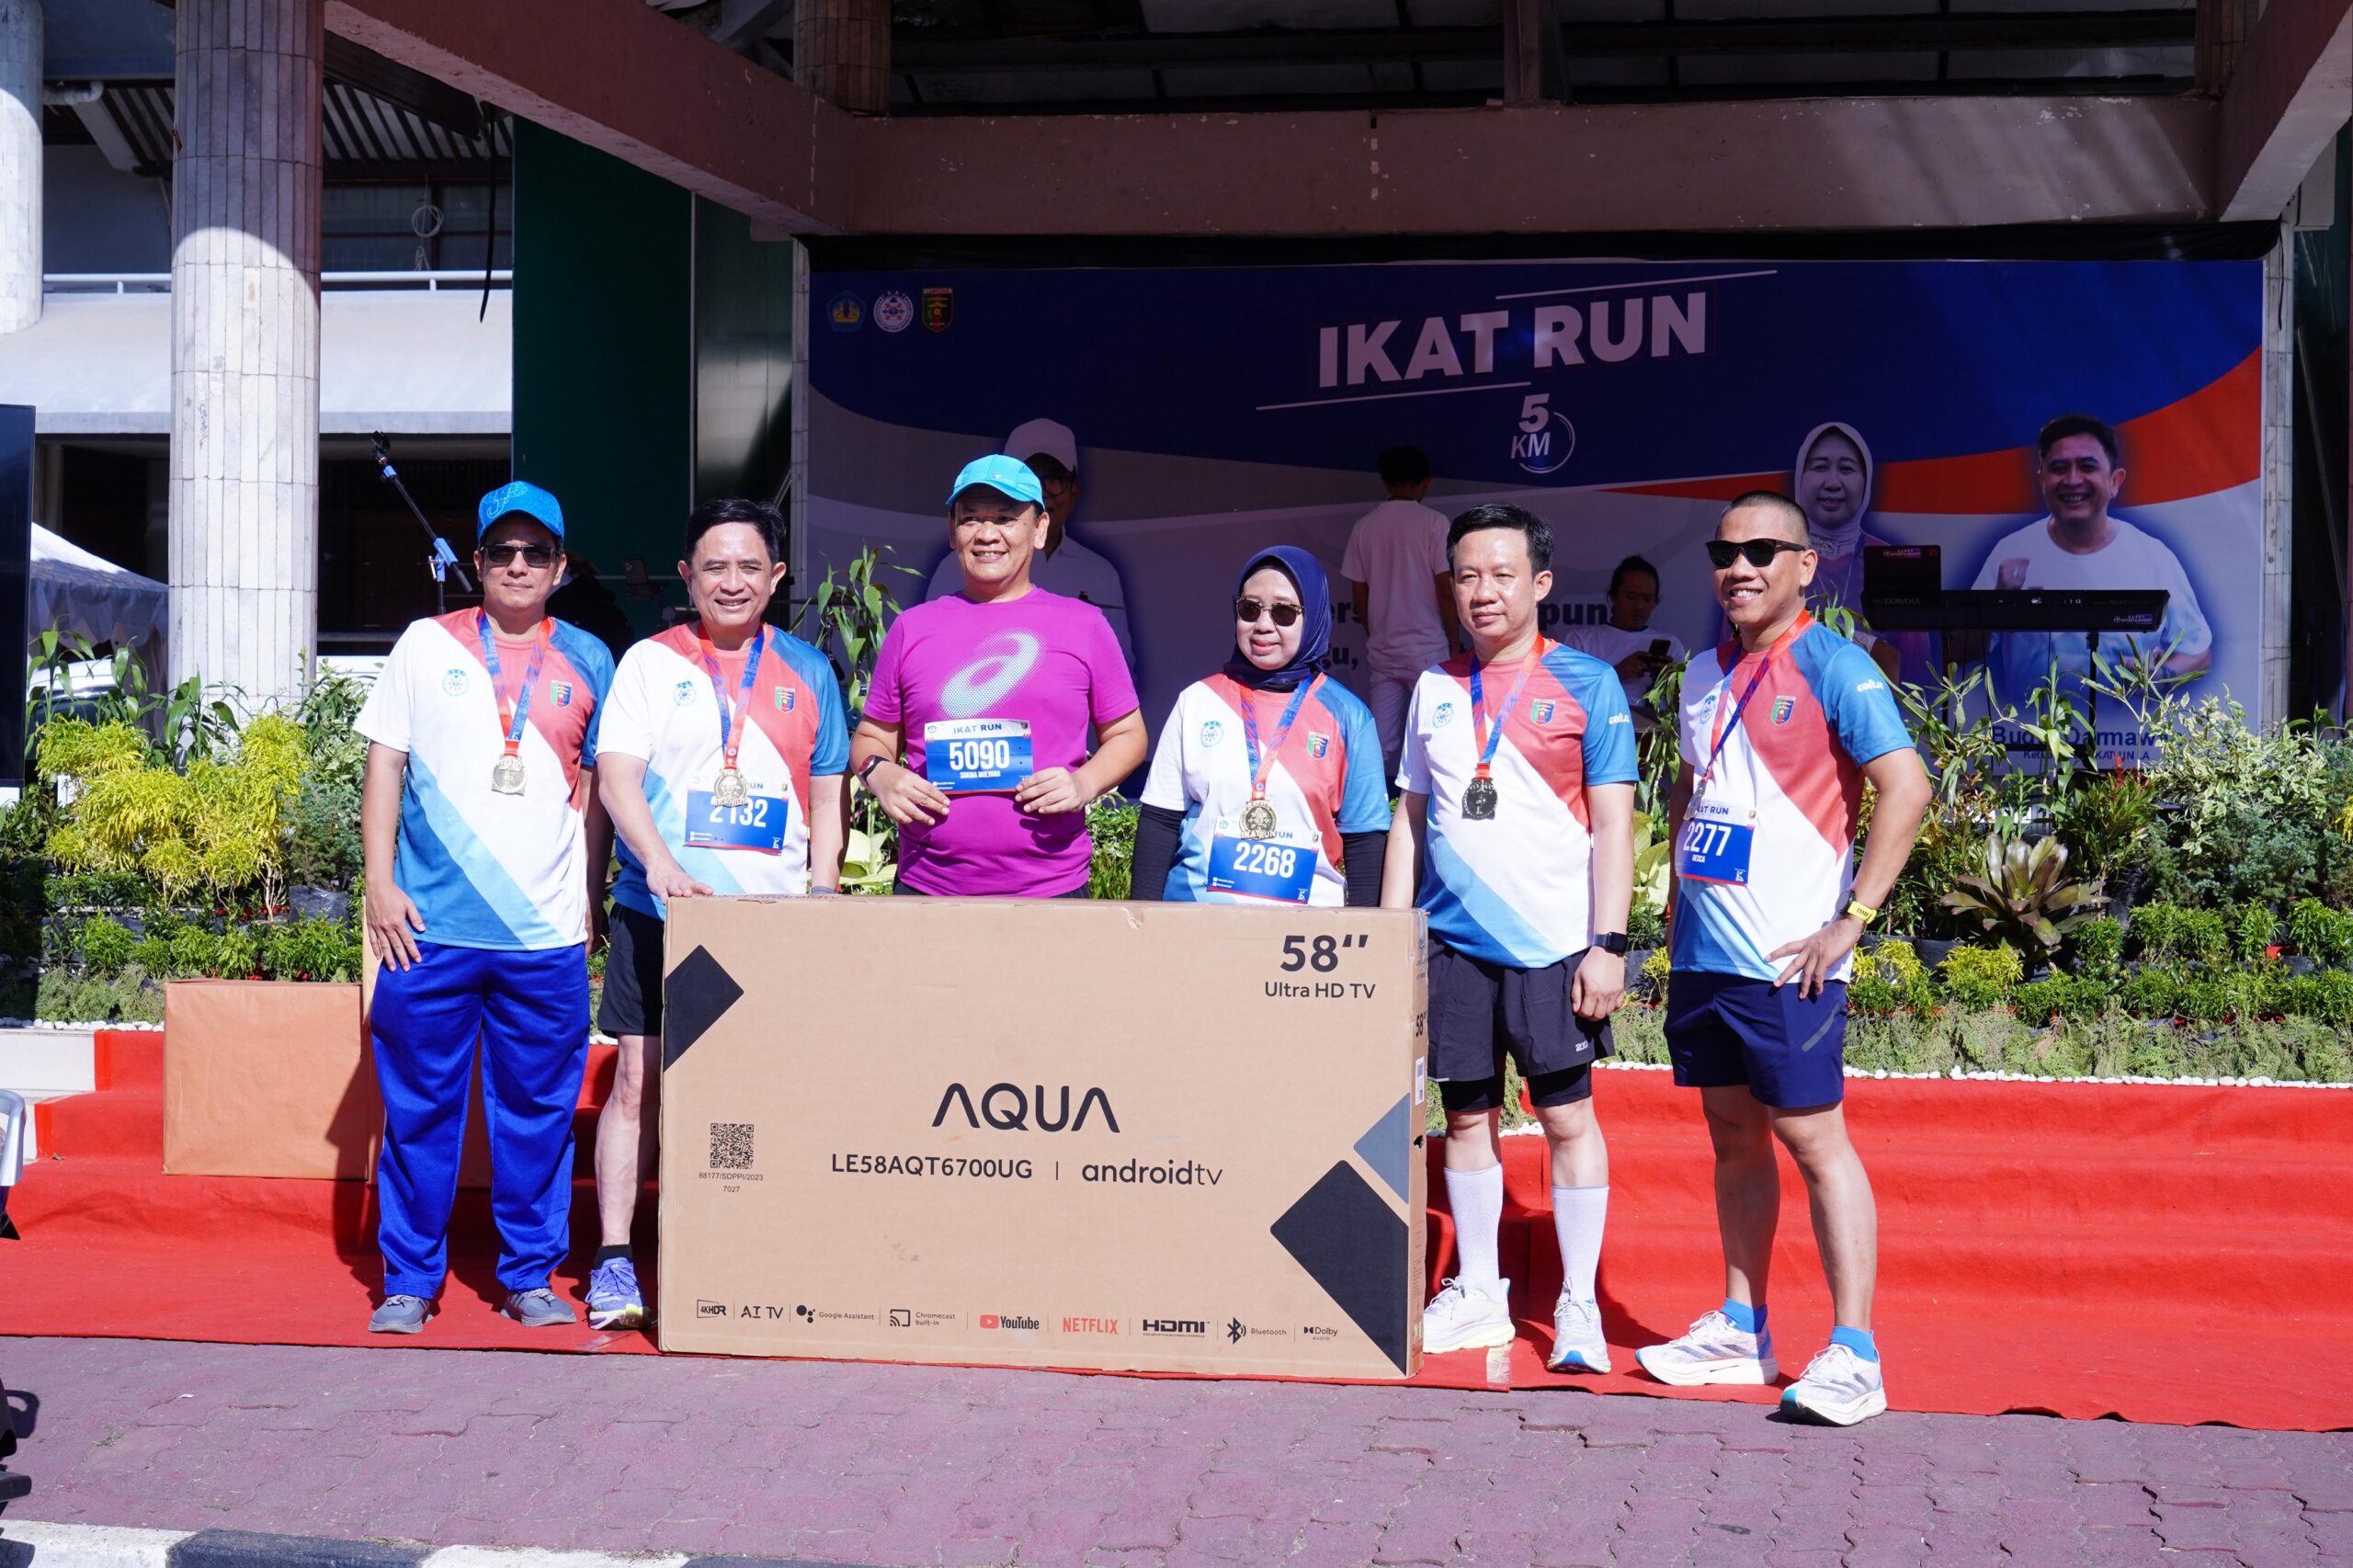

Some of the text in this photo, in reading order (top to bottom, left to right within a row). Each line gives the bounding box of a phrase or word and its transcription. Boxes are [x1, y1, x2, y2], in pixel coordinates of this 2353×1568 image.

[1320, 291, 1707, 388] IKAT RUN
[1518, 393, 1550, 433] 5
[1510, 432, 1552, 460] KM
[1883, 597, 1921, 606] YAMAHA
[954, 723, 1002, 734] IKAT RUN
[949, 739, 1010, 771] 5090
[1711, 806, 1729, 815] RUN
[1683, 821, 1733, 857] 2277
[1233, 842, 1296, 878] 2268
[1265, 982, 1376, 999] Ultra HD TV
[932, 1083, 1120, 1133] AQUA
[699, 1172, 764, 1181] 88177/SDPPI/2023
[832, 1153, 1223, 1186] LE58AQT6700UG androidtv
[741, 1306, 784, 1320] AI TV
[819, 1311, 875, 1321] Google Assistant
[915, 1312, 956, 1321] Chromecast
[1000, 1315, 1040, 1331] YouTube
[1063, 1317, 1119, 1335] NETFLIX
[1251, 1326, 1287, 1335] Bluetooth
[1314, 1326, 1338, 1337] Dolby
